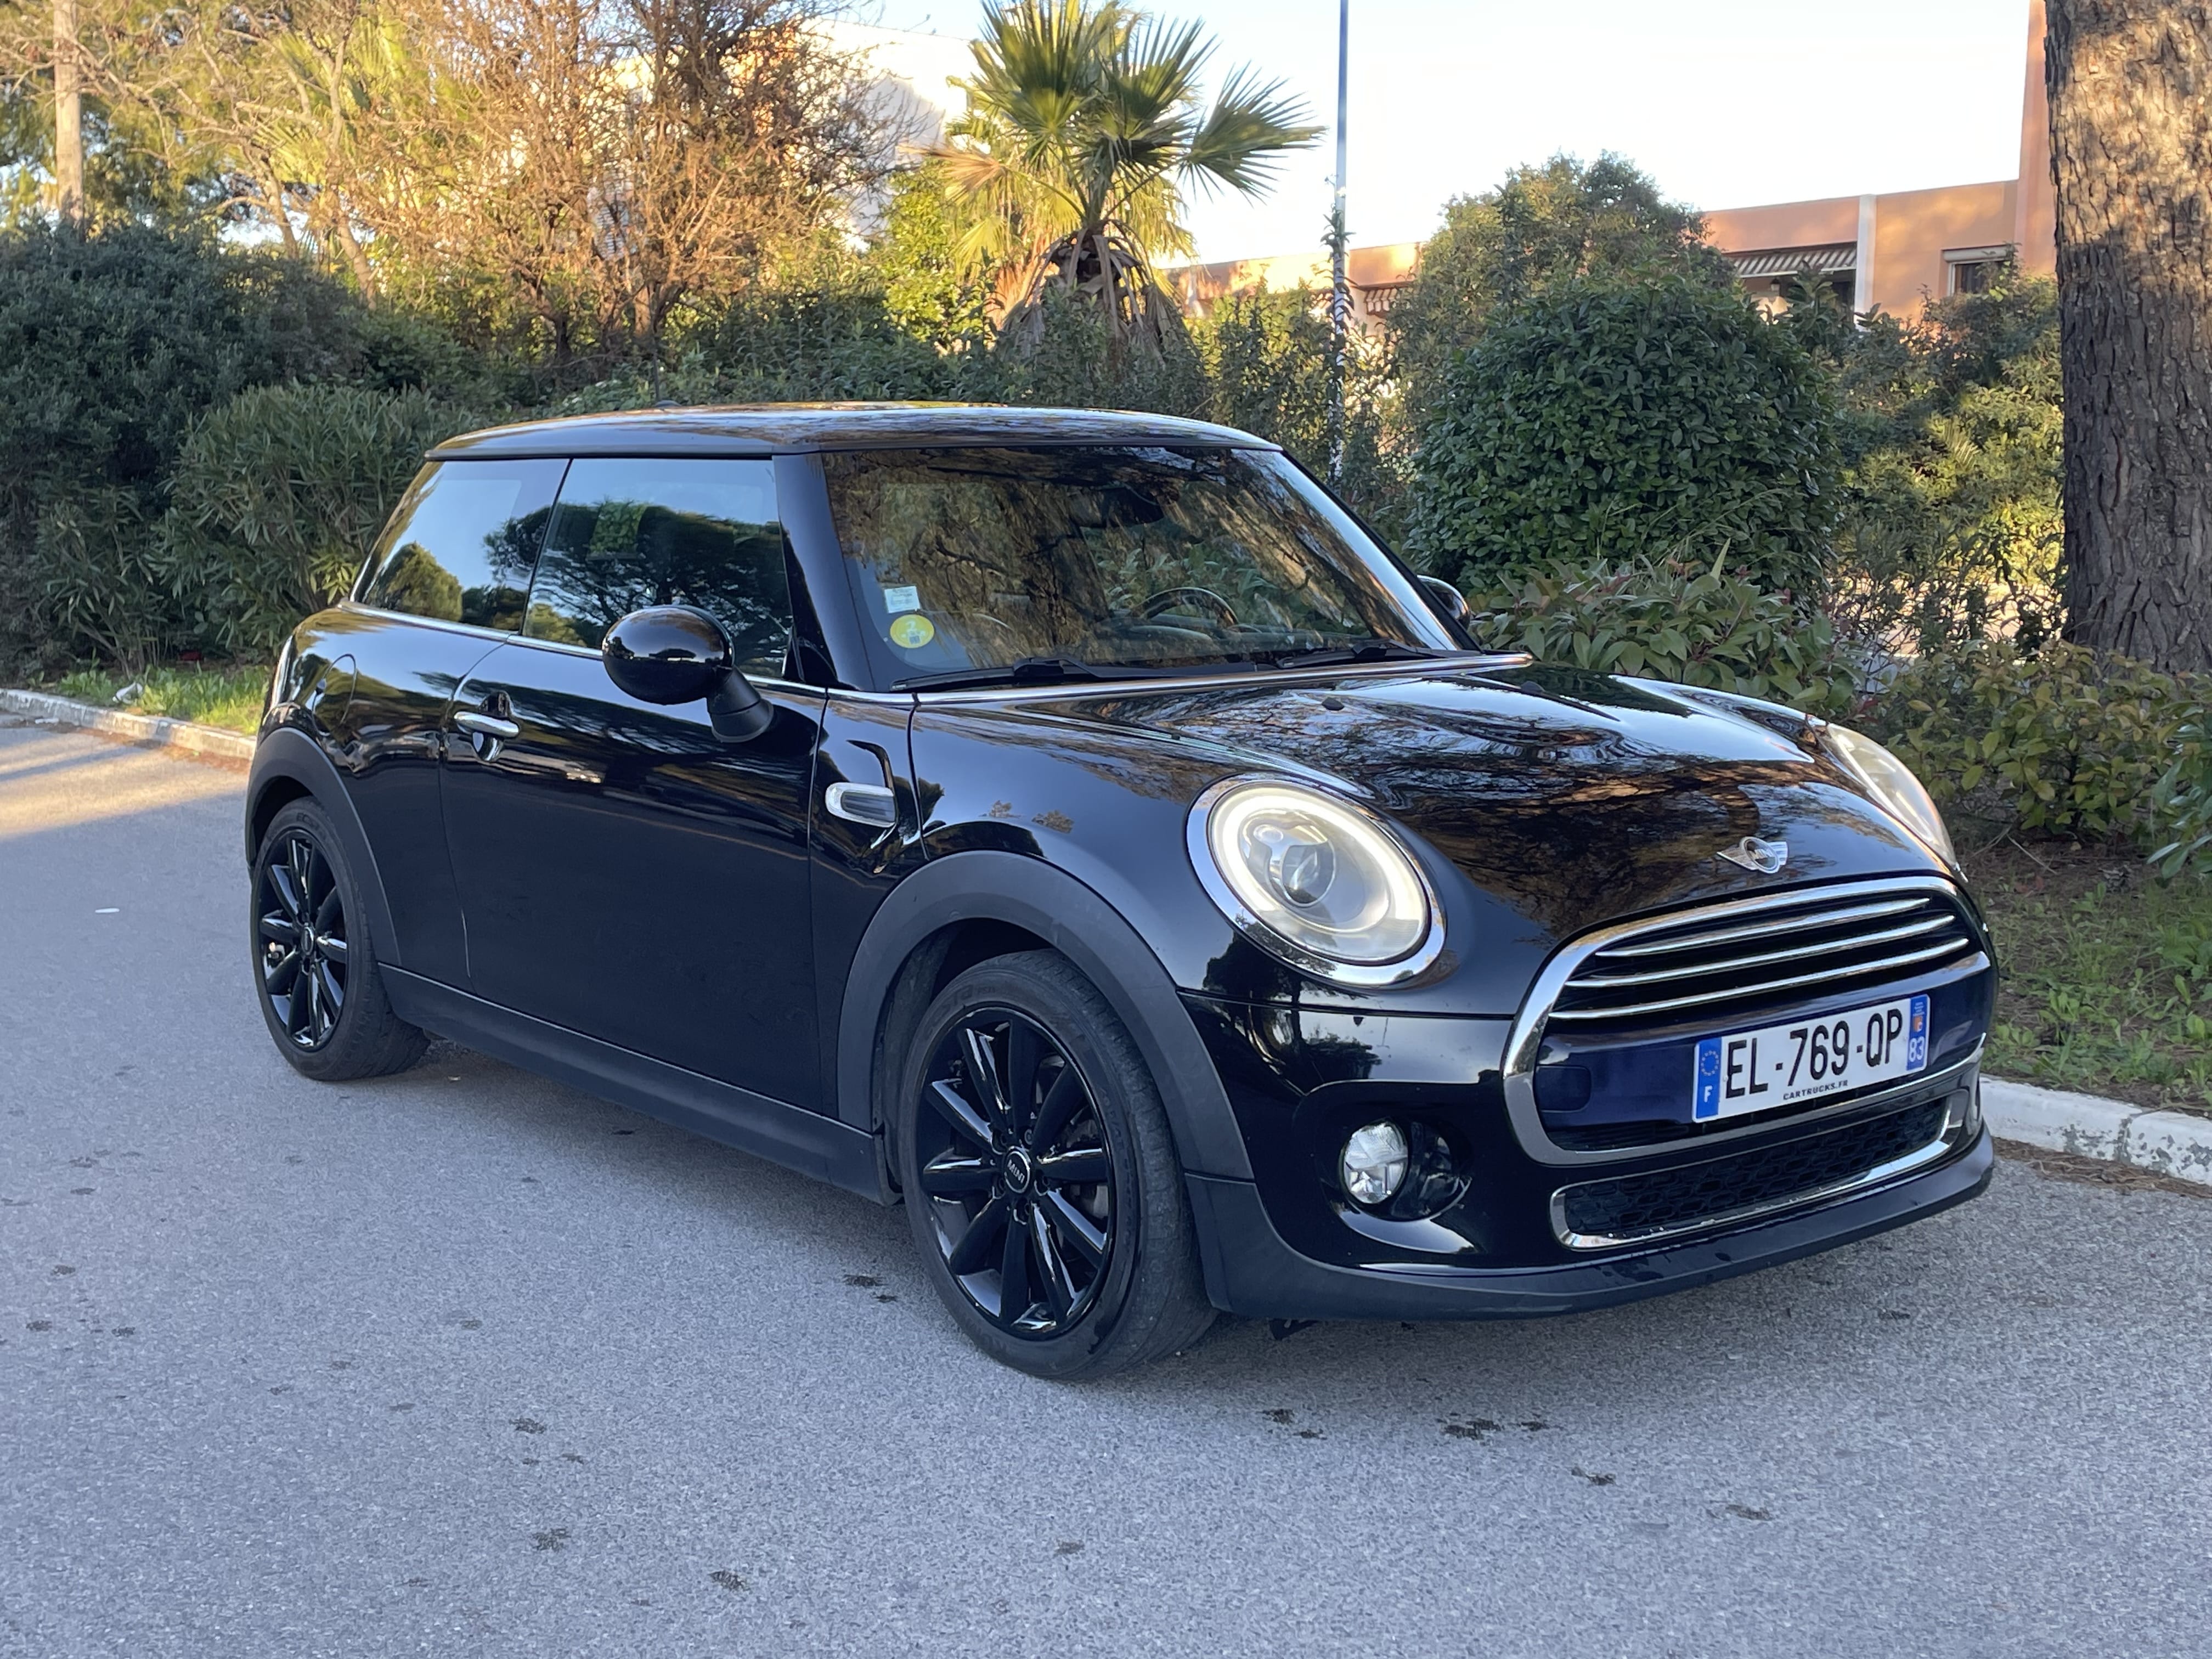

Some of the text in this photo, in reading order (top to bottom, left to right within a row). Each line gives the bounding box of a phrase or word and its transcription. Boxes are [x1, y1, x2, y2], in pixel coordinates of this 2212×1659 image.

[1725, 1008, 1903, 1099] EL-769-QP
[1909, 1035, 1925, 1062] 83
[1703, 1085, 1713, 1103] F
[1782, 1079, 1848, 1101] CARTRUCKS.FR
